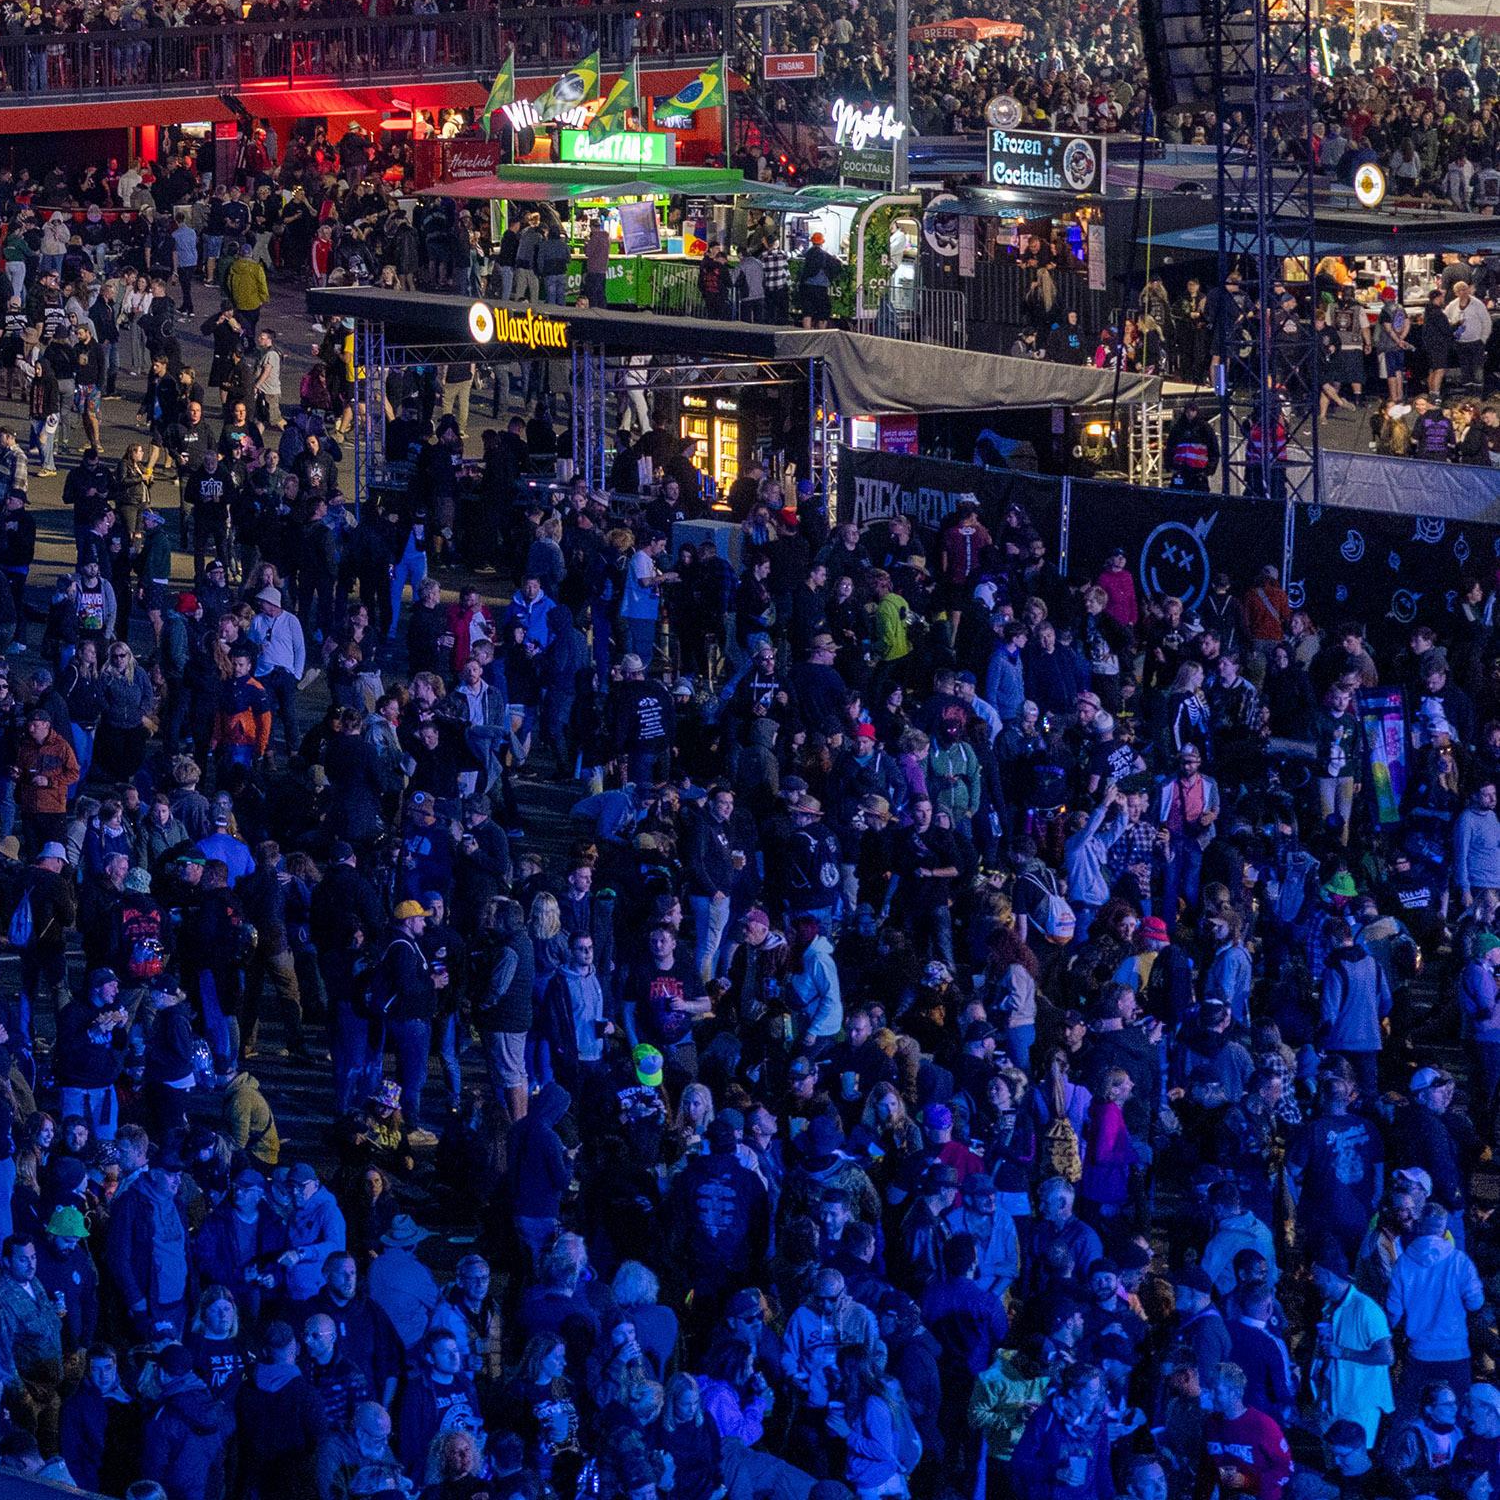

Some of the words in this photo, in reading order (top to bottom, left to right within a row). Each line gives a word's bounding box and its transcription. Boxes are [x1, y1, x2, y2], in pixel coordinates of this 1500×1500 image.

[924, 28, 958, 39] BREZEL
[777, 61, 805, 72] EINGANG
[992, 130, 1042, 156] Frozen
[451, 153, 494, 170] Herzlich
[843, 161, 891, 175] COCKTAILS
[451, 169, 493, 178] willkommen
[992, 161, 1062, 189] Cocktails
[494, 307, 568, 350] Warsteiner
[852, 476, 902, 523] ROCK
